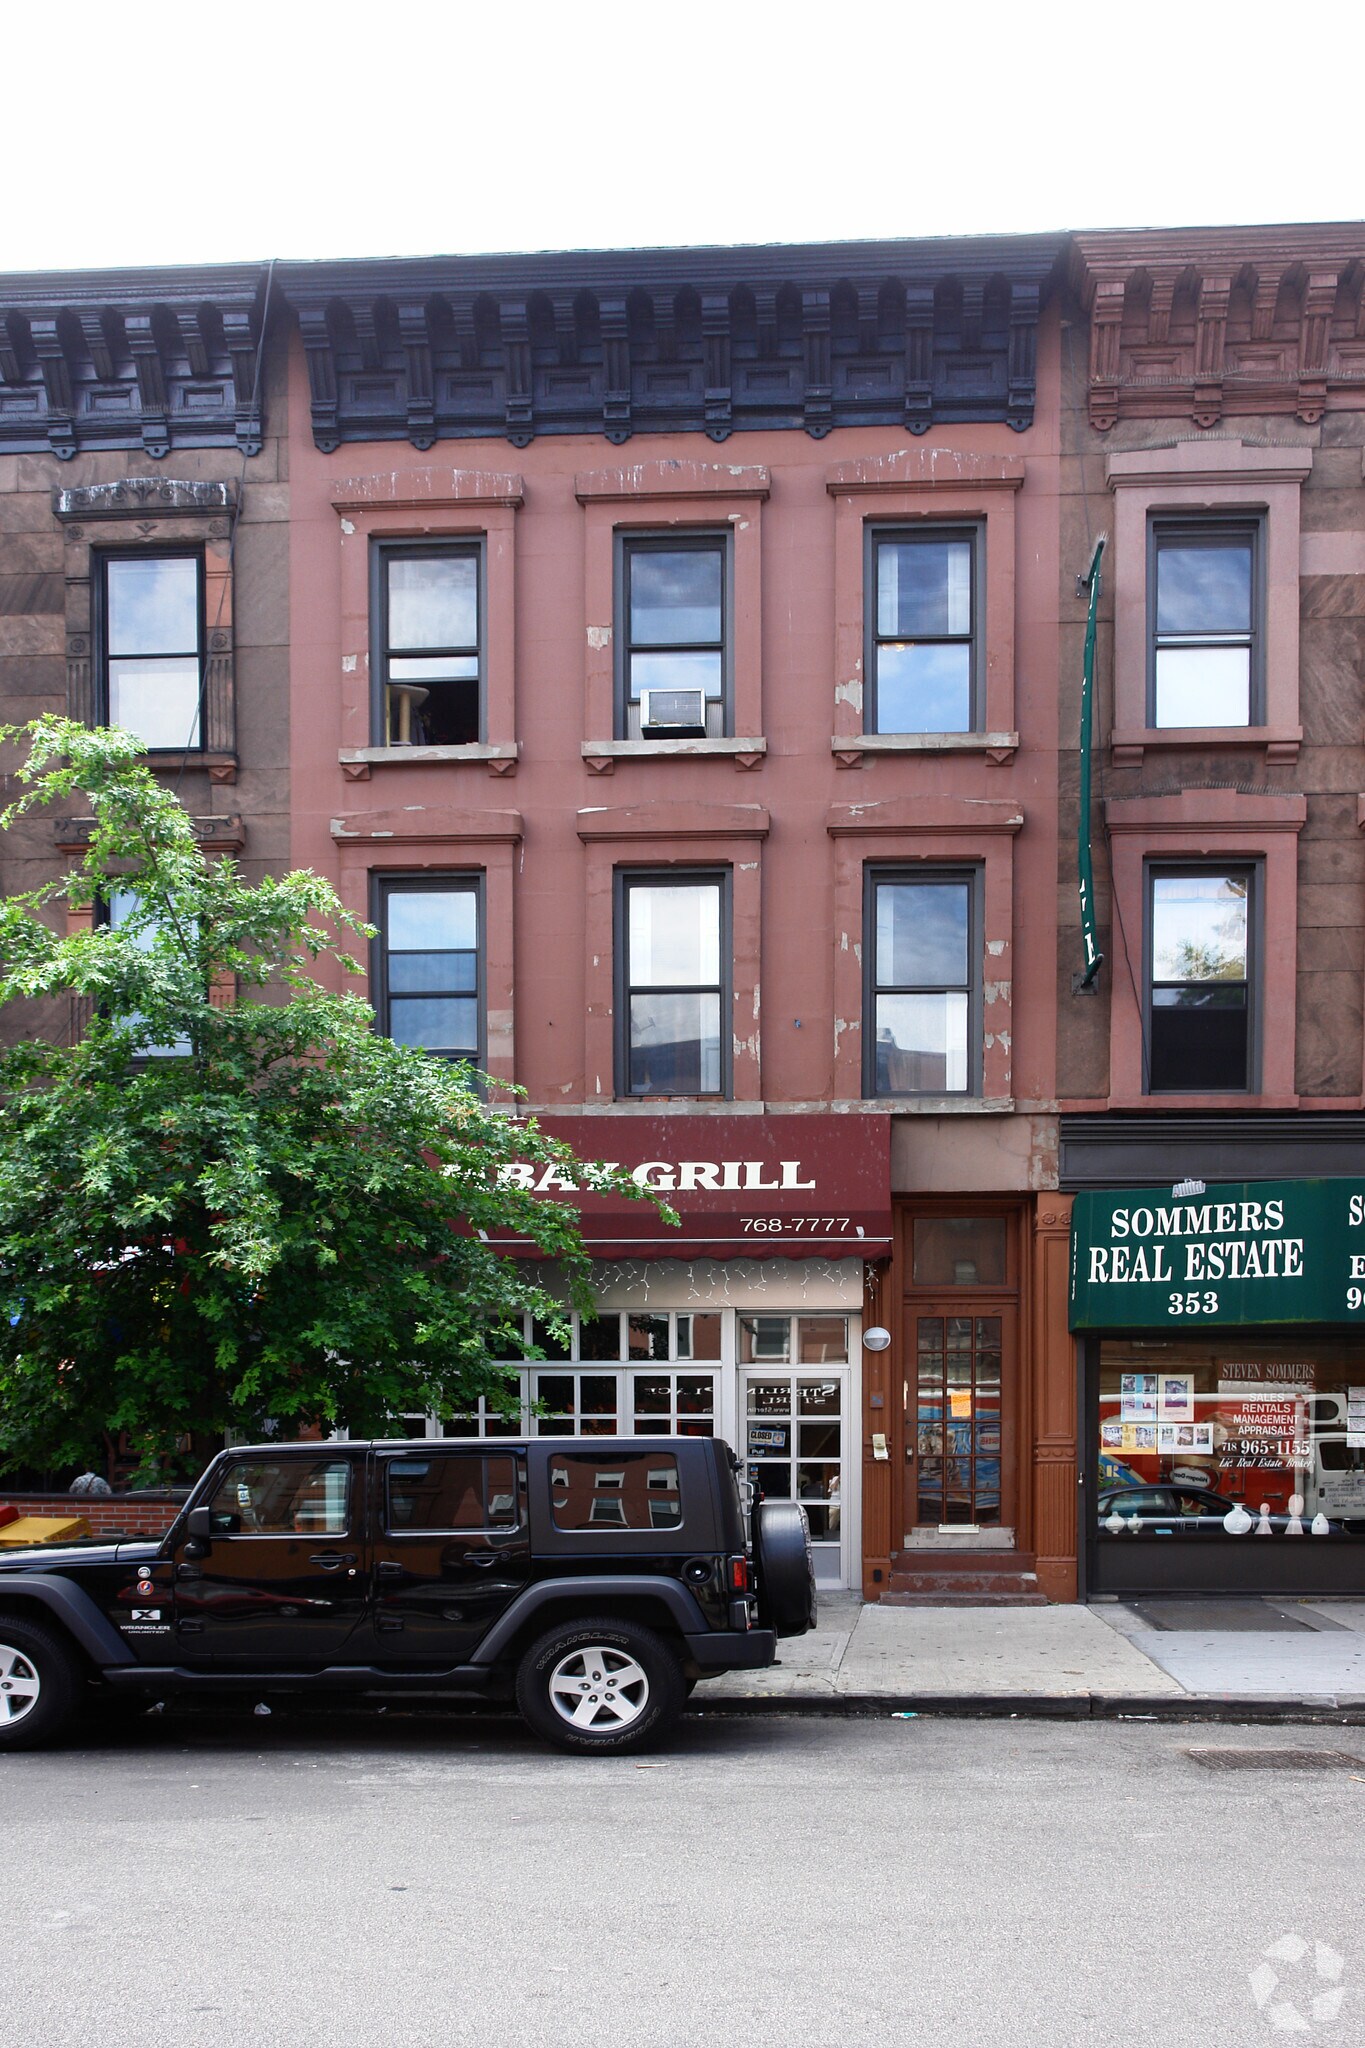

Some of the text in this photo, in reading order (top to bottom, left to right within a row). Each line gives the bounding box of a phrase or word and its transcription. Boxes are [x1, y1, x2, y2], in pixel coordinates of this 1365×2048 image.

[632, 1161, 816, 1191] GRILL
[740, 1218, 850, 1232] 768-7777
[1111, 1200, 1284, 1238] SOMMERS
[1087, 1245, 1173, 1283] REAL
[1184, 1238, 1304, 1281] ESTATE
[1167, 1291, 1219, 1315] 353
[1222, 1363, 1315, 1379] STEVEN SOMMERS
[1249, 1393, 1285, 1402] SALES
[1242, 1403, 1291, 1413] RENTALS
[1233, 1414, 1299, 1424] MANAGEMENT
[751, 1431, 772, 1440] CLOSED
[1238, 1425, 1295, 1436] APPRAISALS
[1222, 1439, 1310, 1455] 718 965-1155
[1236, 1457, 1256, 1468] Real
[1257, 1457, 1284, 1468] Estate
[536, 1632, 630, 1671] WRANGLER
